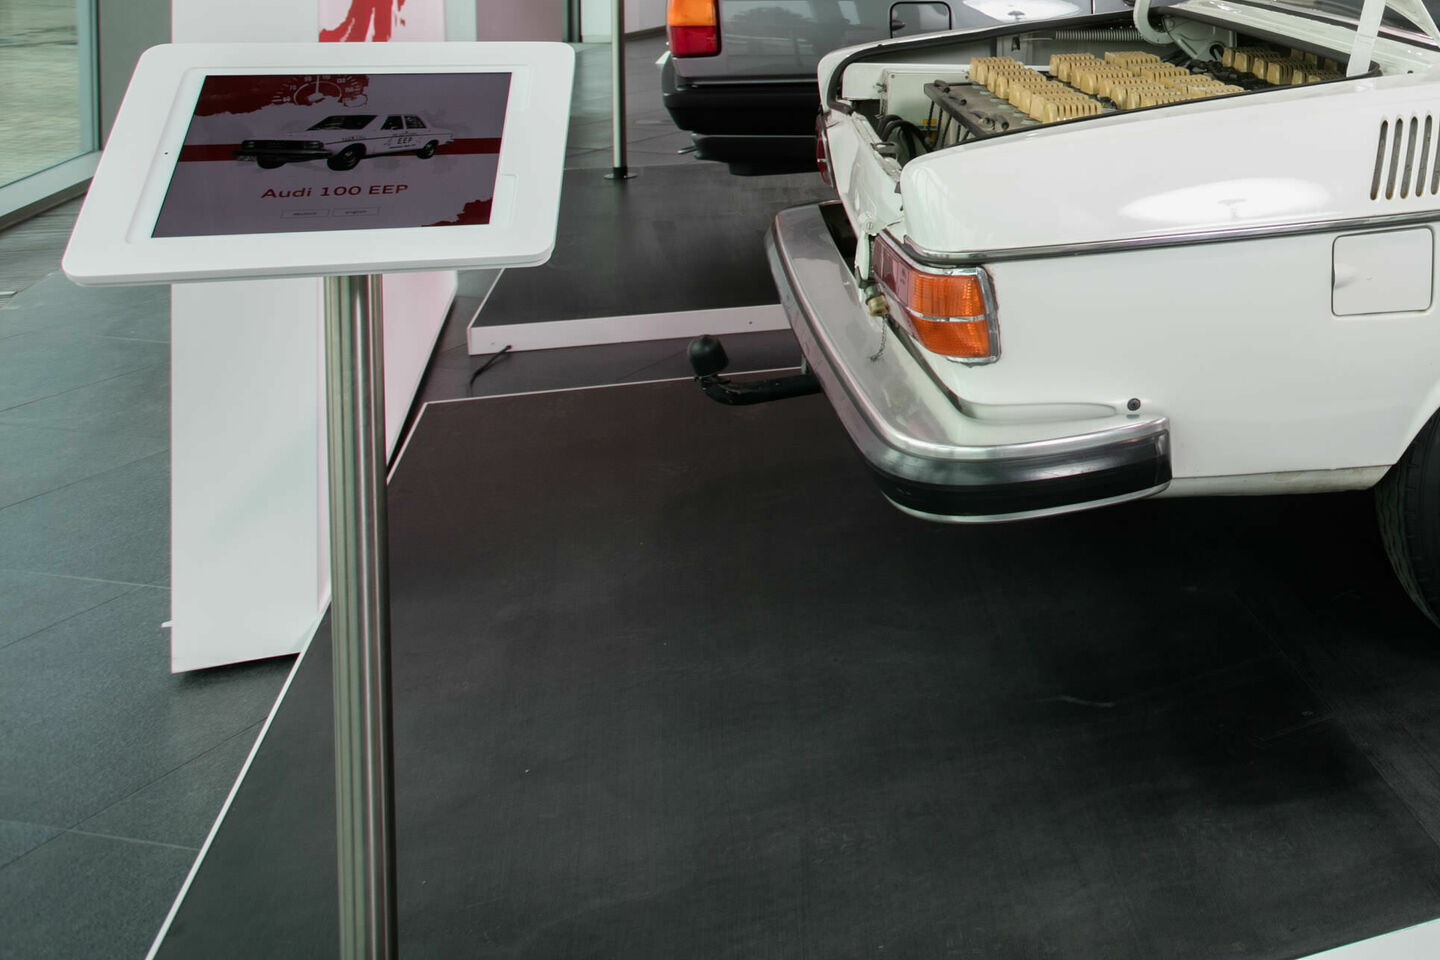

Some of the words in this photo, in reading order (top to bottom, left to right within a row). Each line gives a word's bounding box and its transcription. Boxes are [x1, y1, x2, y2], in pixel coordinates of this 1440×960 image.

[261, 187, 312, 198] Audi
[320, 185, 362, 197] 100
[368, 184, 408, 195] EEP
